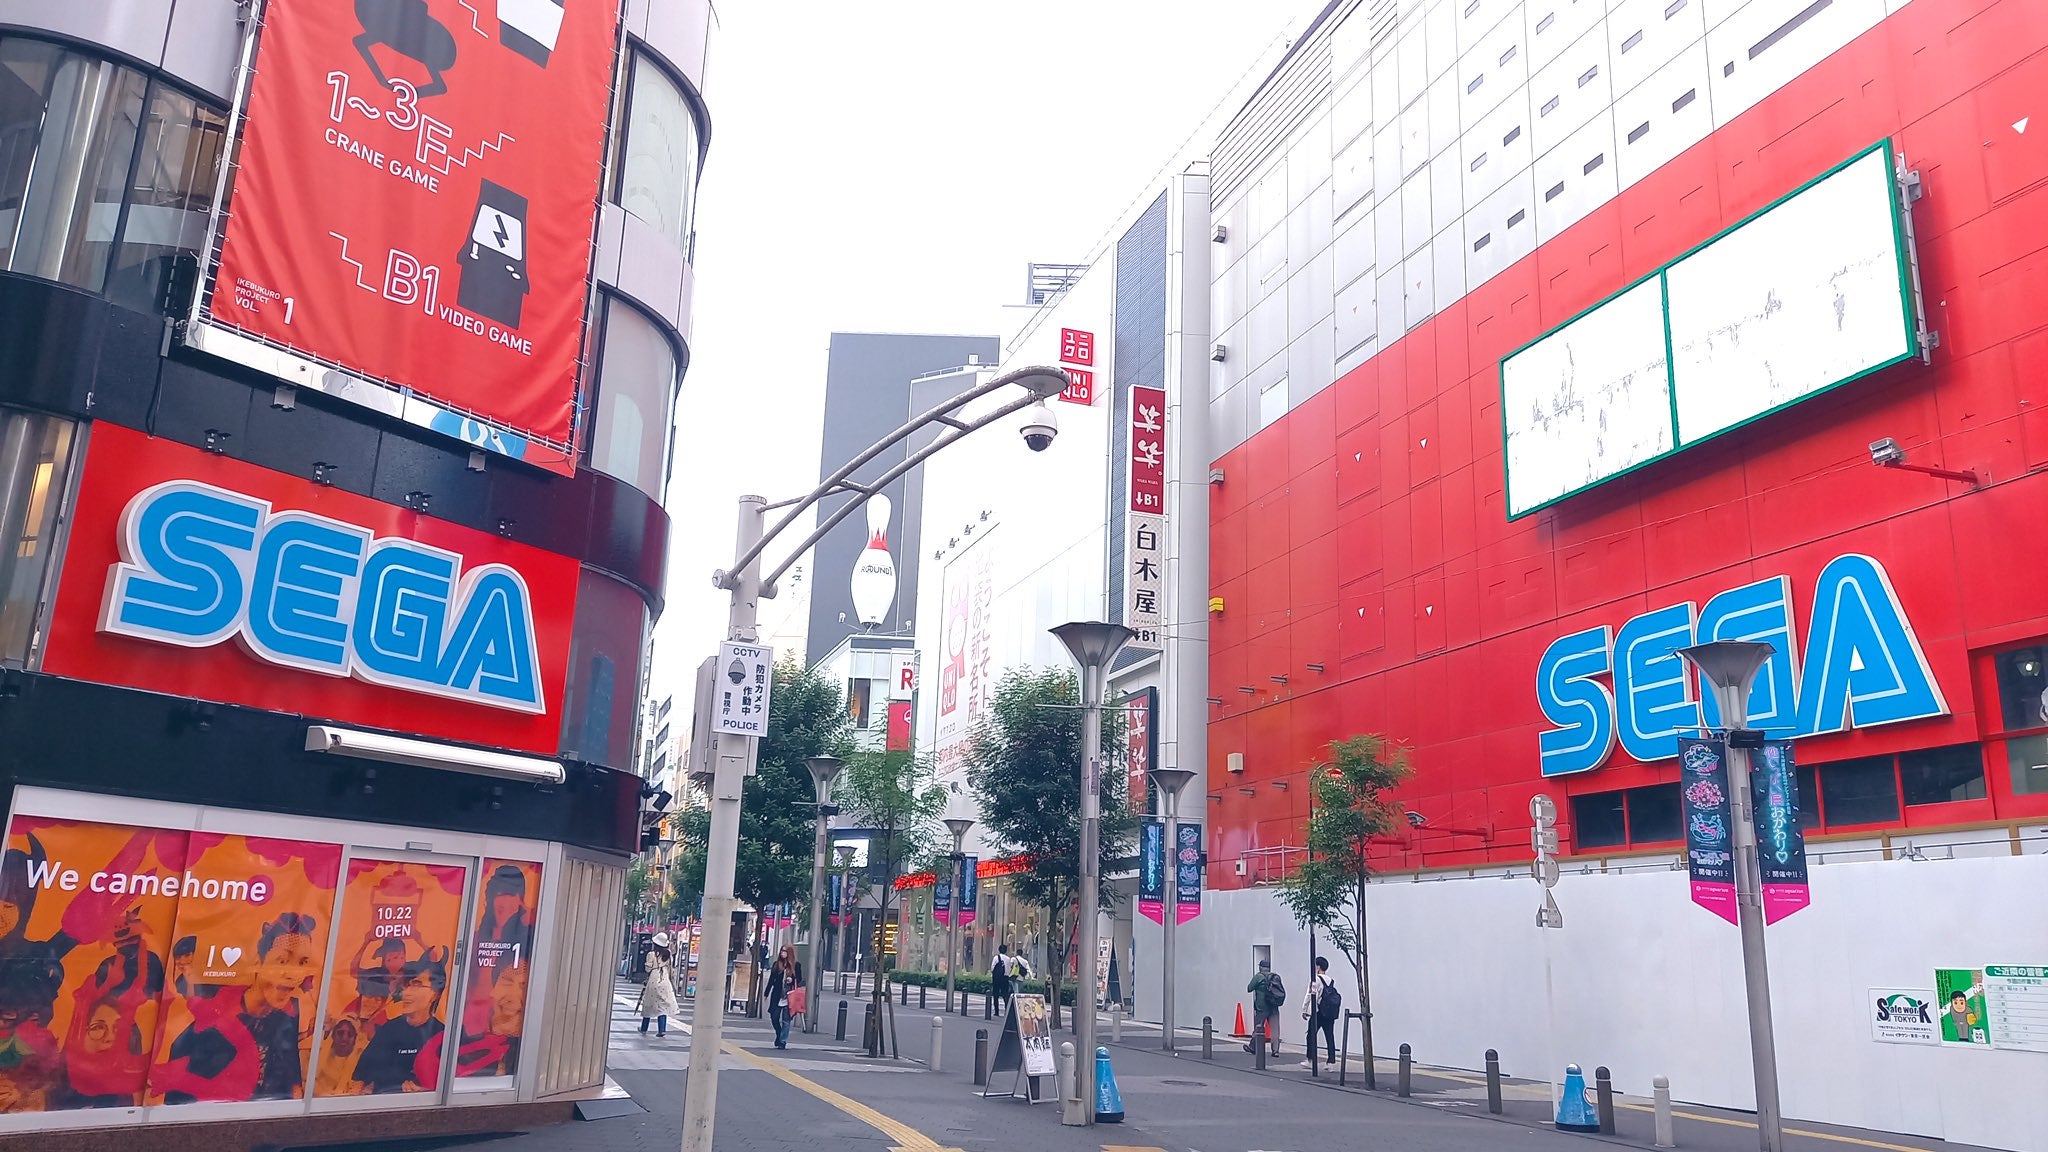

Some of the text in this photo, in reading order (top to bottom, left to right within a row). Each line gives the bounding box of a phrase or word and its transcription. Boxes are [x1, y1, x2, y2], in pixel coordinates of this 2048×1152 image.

[325, 128, 439, 193] CRANE GAME
[235, 277, 281, 301] IKEBUKURO
[382, 248, 440, 316] B1
[234, 286, 270, 305] PROJECT
[234, 294, 294, 325] VOL. 1
[439, 303, 532, 355] VIDEO GAME
[1144, 493, 1158, 507] B1
[1133, 523, 1159, 615] 白木屋
[97, 479, 546, 714] SEGA
[1142, 630, 1156, 642] B1
[733, 647, 761, 658] CCTV
[1536, 553, 1950, 777] SEGA
[741, 686, 753, 716] 作動中
[754, 664, 765, 714] 防犯カメラ
[722, 691, 732, 715] 警視庁
[722, 719, 759, 731] POLICE
[26, 859, 80, 891] We
[377, 907, 412, 921] 10.22
[375, 924, 411, 938] OPEN
[478, 941, 512, 950] IKEBUKURO
[478, 943, 521, 969] VOL. 1
[1893, 1015, 1917, 1024] TOKYO
